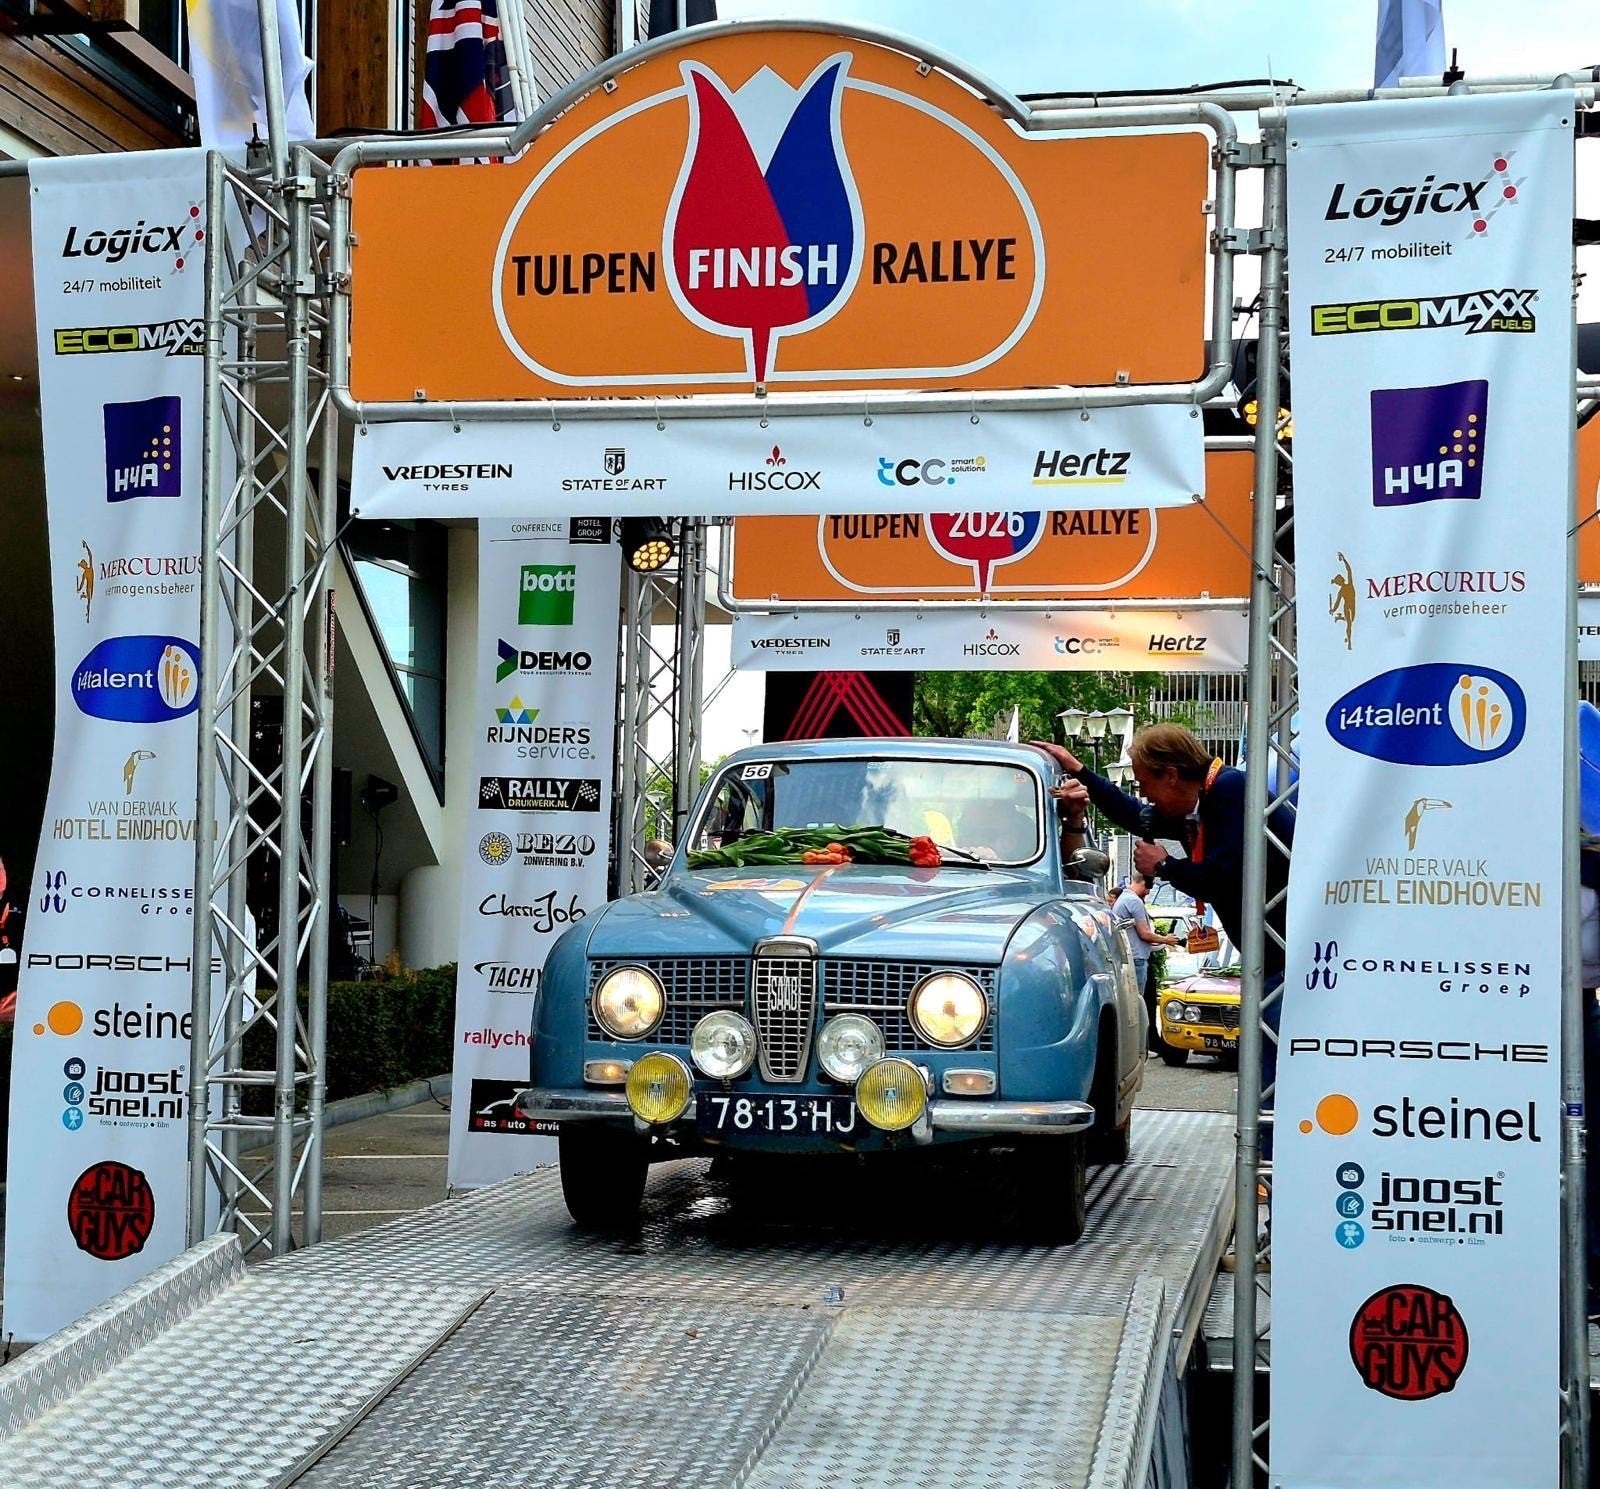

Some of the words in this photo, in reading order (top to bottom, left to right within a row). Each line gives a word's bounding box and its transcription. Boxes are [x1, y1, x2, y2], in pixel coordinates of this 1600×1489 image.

[1324, 174, 1488, 226] Logicx
[62, 220, 186, 263] Logicx
[1324, 246, 1365, 263] 24/7
[1370, 241, 1453, 260] mobiliteit
[512, 251, 656, 297] TULPEN
[688, 243, 839, 290] FINISH
[872, 238, 1017, 285] RALLYE
[62, 280, 94, 294] 24/7
[99, 275, 162, 293] mobiliteit
[1313, 290, 1534, 333] ECOMAXX
[1491, 319, 1533, 330] FUELS
[182, 344, 206, 353] FUE
[382, 463, 513, 481] VREDESTEIN
[951, 459, 975, 467] smart
[951, 465, 987, 473] solutions
[1033, 448, 1131, 478] Hertz
[114, 462, 159, 492] H4A
[423, 483, 469, 492] TYRES
[561, 479, 613, 492] STATE
[615, 478, 631, 488] OF
[632, 478, 668, 491] ART
[728, 470, 822, 491] HISCOX
[1384, 459, 1463, 495] H4A
[511, 523, 562, 533] CONFERENCE
[577, 519, 602, 527] HOTEL
[577, 528, 602, 537] GROUP
[830, 513, 920, 540] TULPEN
[948, 511, 1025, 538] 2026
[1052, 509, 1139, 536] RALLYE
[523, 571, 577, 592] bott
[1366, 570, 1527, 599] MERCURIUS
[1383, 601, 1508, 619] vermogensbeheer
[750, 637, 831, 648] VREDESTEIN
[860, 647, 892, 655] STATE
[903, 647, 926, 655] ART
[963, 643, 1021, 656] HISCOX
[1148, 634, 1208, 651] Hertz
[520, 651, 592, 671] DEMO
[77, 667, 154, 692] i4talent
[1339, 702, 1443, 730] i4talent
[487, 726, 591, 745] RIJNDERS
[744, 766, 769, 778] 56
[508, 780, 570, 799] RALLY
[88, 801, 119, 816] VAN
[123, 801, 145, 816] DER
[148, 801, 178, 816] VALK
[508, 798, 569, 808] DRUKWERK.NL
[53, 818, 112, 840] HOTEL
[116, 818, 218, 841] EINDHOV
[515, 832, 596, 857] BEZO
[523, 856, 568, 867] ZONWERING
[570, 858, 585, 868] B.V.
[1366, 856, 1398, 876] VAN
[1403, 857, 1439, 877] DER
[1443, 858, 1488, 878] VALK
[71, 886, 193, 899] CORNELISSE
[1324, 879, 1390, 905] HOTEL
[1396, 879, 1541, 907] EINDHOVEN
[141, 903, 192, 915] Groe
[28, 953, 222, 974] PORSCHE
[1343, 958, 1531, 976] CORNELISSEN
[770, 976, 798, 1011] SAAB
[1439, 979, 1531, 998] Groep
[93, 1002, 192, 1040] steine
[1290, 1038, 1548, 1063] PORSCHE
[90, 1066, 183, 1095] joost
[88, 1097, 183, 1119] snel.nl
[711, 1097, 856, 1132] 78-13-HJ
[475, 1118, 497, 1128] Bas
[500, 1119, 526, 1130] Auto
[529, 1120, 559, 1131] Servic
[1372, 1096, 1541, 1143] steinel
[95, 1167, 147, 1208] CAR
[1372, 1172, 1503, 1206] joost
[77, 1210, 147, 1253] GUYS
[1371, 1207, 1503, 1235] snel.nl
[1388, 1234, 1406, 1243] foto
[1418, 1235, 1456, 1246] ontwerp
[1467, 1237, 1486, 1246] film
[1386, 1292, 1455, 1338] CAR
[1363, 1342, 1458, 1393] GUYS
